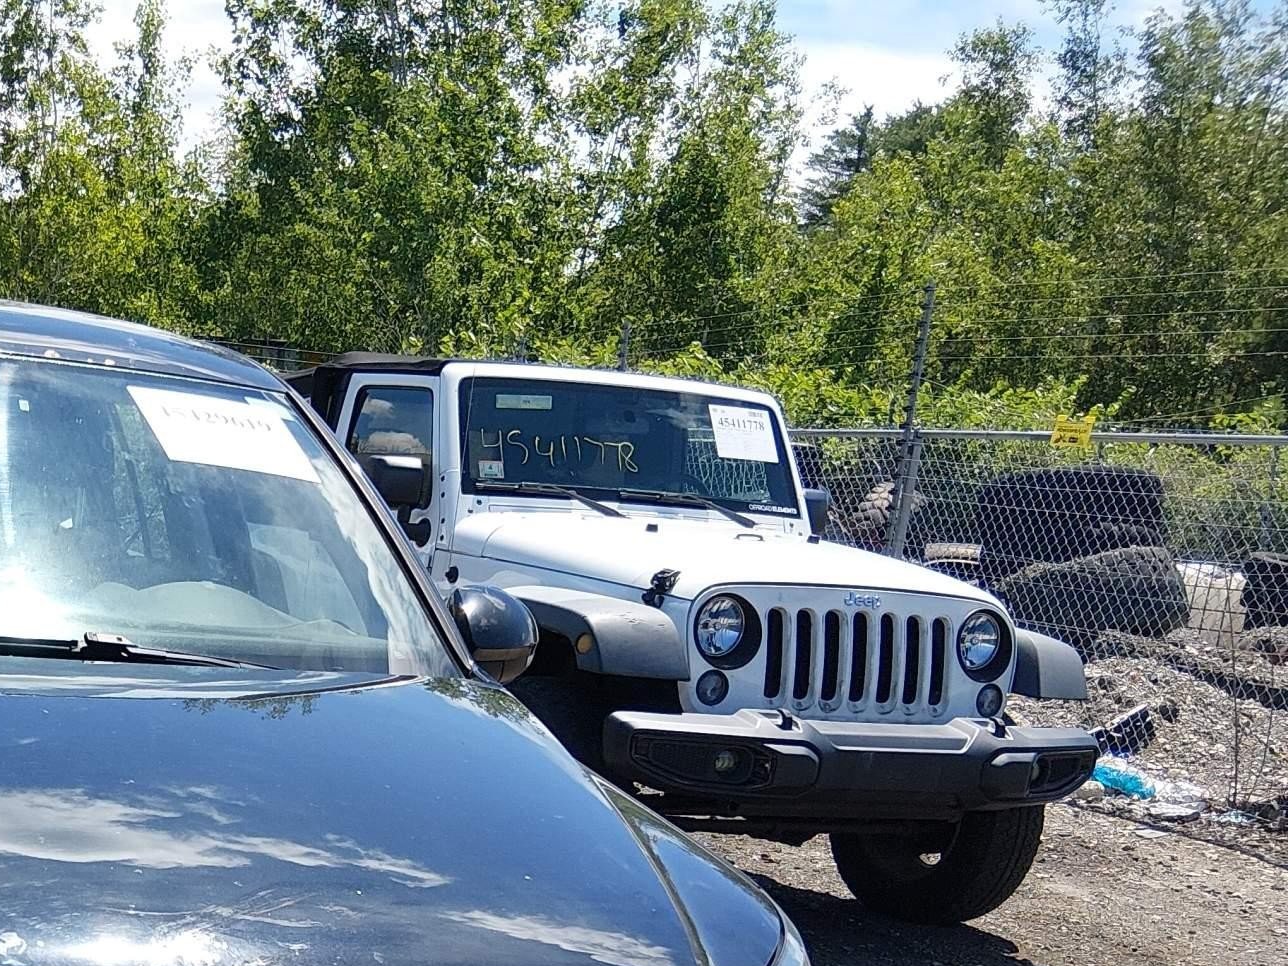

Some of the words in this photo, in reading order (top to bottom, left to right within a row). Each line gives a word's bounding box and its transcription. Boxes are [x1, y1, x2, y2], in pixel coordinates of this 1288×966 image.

[718, 418, 764, 431] 45411778
[481, 429, 639, 472] 45411778
[844, 591, 881, 609] Jeep
